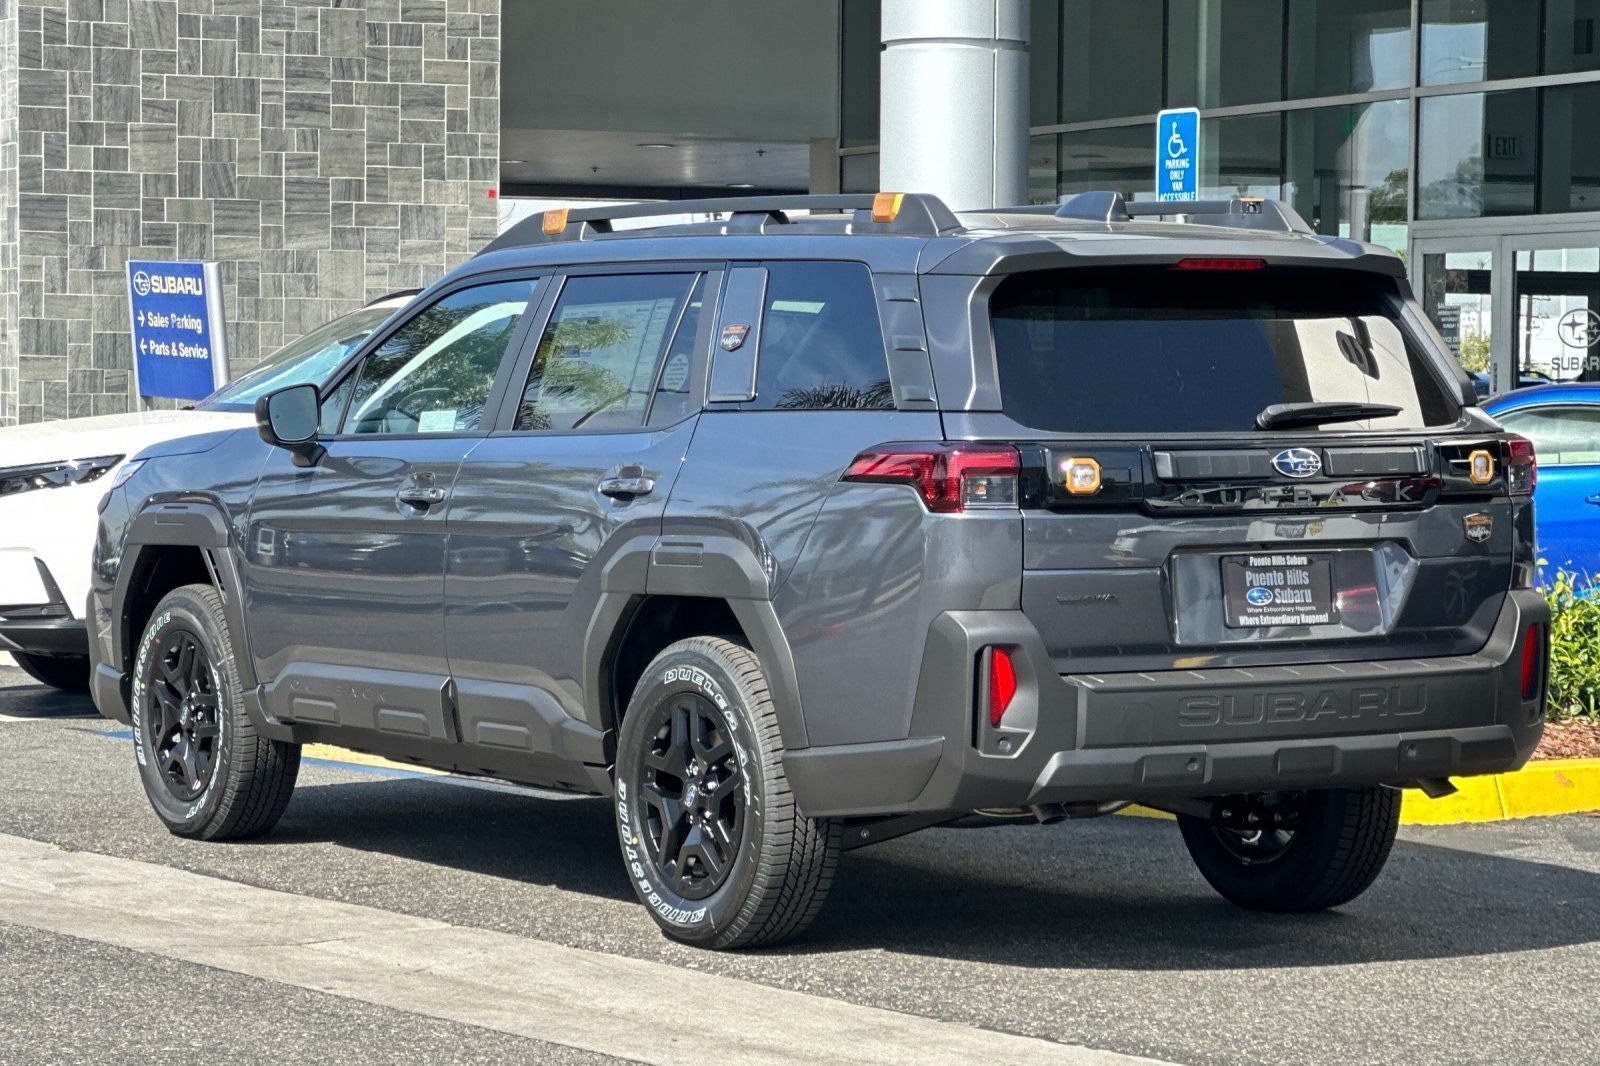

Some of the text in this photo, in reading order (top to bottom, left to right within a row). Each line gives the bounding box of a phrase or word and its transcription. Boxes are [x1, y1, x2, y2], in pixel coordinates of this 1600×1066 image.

[1495, 136, 1517, 156] EXIT
[1165, 158, 1190, 169] PARKING
[1169, 170, 1185, 181] ONLY
[1171, 181, 1183, 192] VAN
[150, 275, 203, 296] SUBARU
[147, 312, 203, 334] Sales Parking
[149, 340, 208, 359] Parts & Service
[1551, 356, 1600, 371] SUBAR
[1180, 482, 1414, 504] OUTBACK
[1249, 555, 1308, 567] Puente Hills Subaru
[1245, 568, 1310, 587] Puente Hills
[1274, 588, 1312, 604] Subaru
[1239, 615, 1259, 626] Where
[1259, 614, 1300, 625] Extraordinary
[664, 667, 739, 732] DUELER
[1178, 684, 1428, 727] SUBARU
[617, 777, 707, 923] BRIDGESTONE
